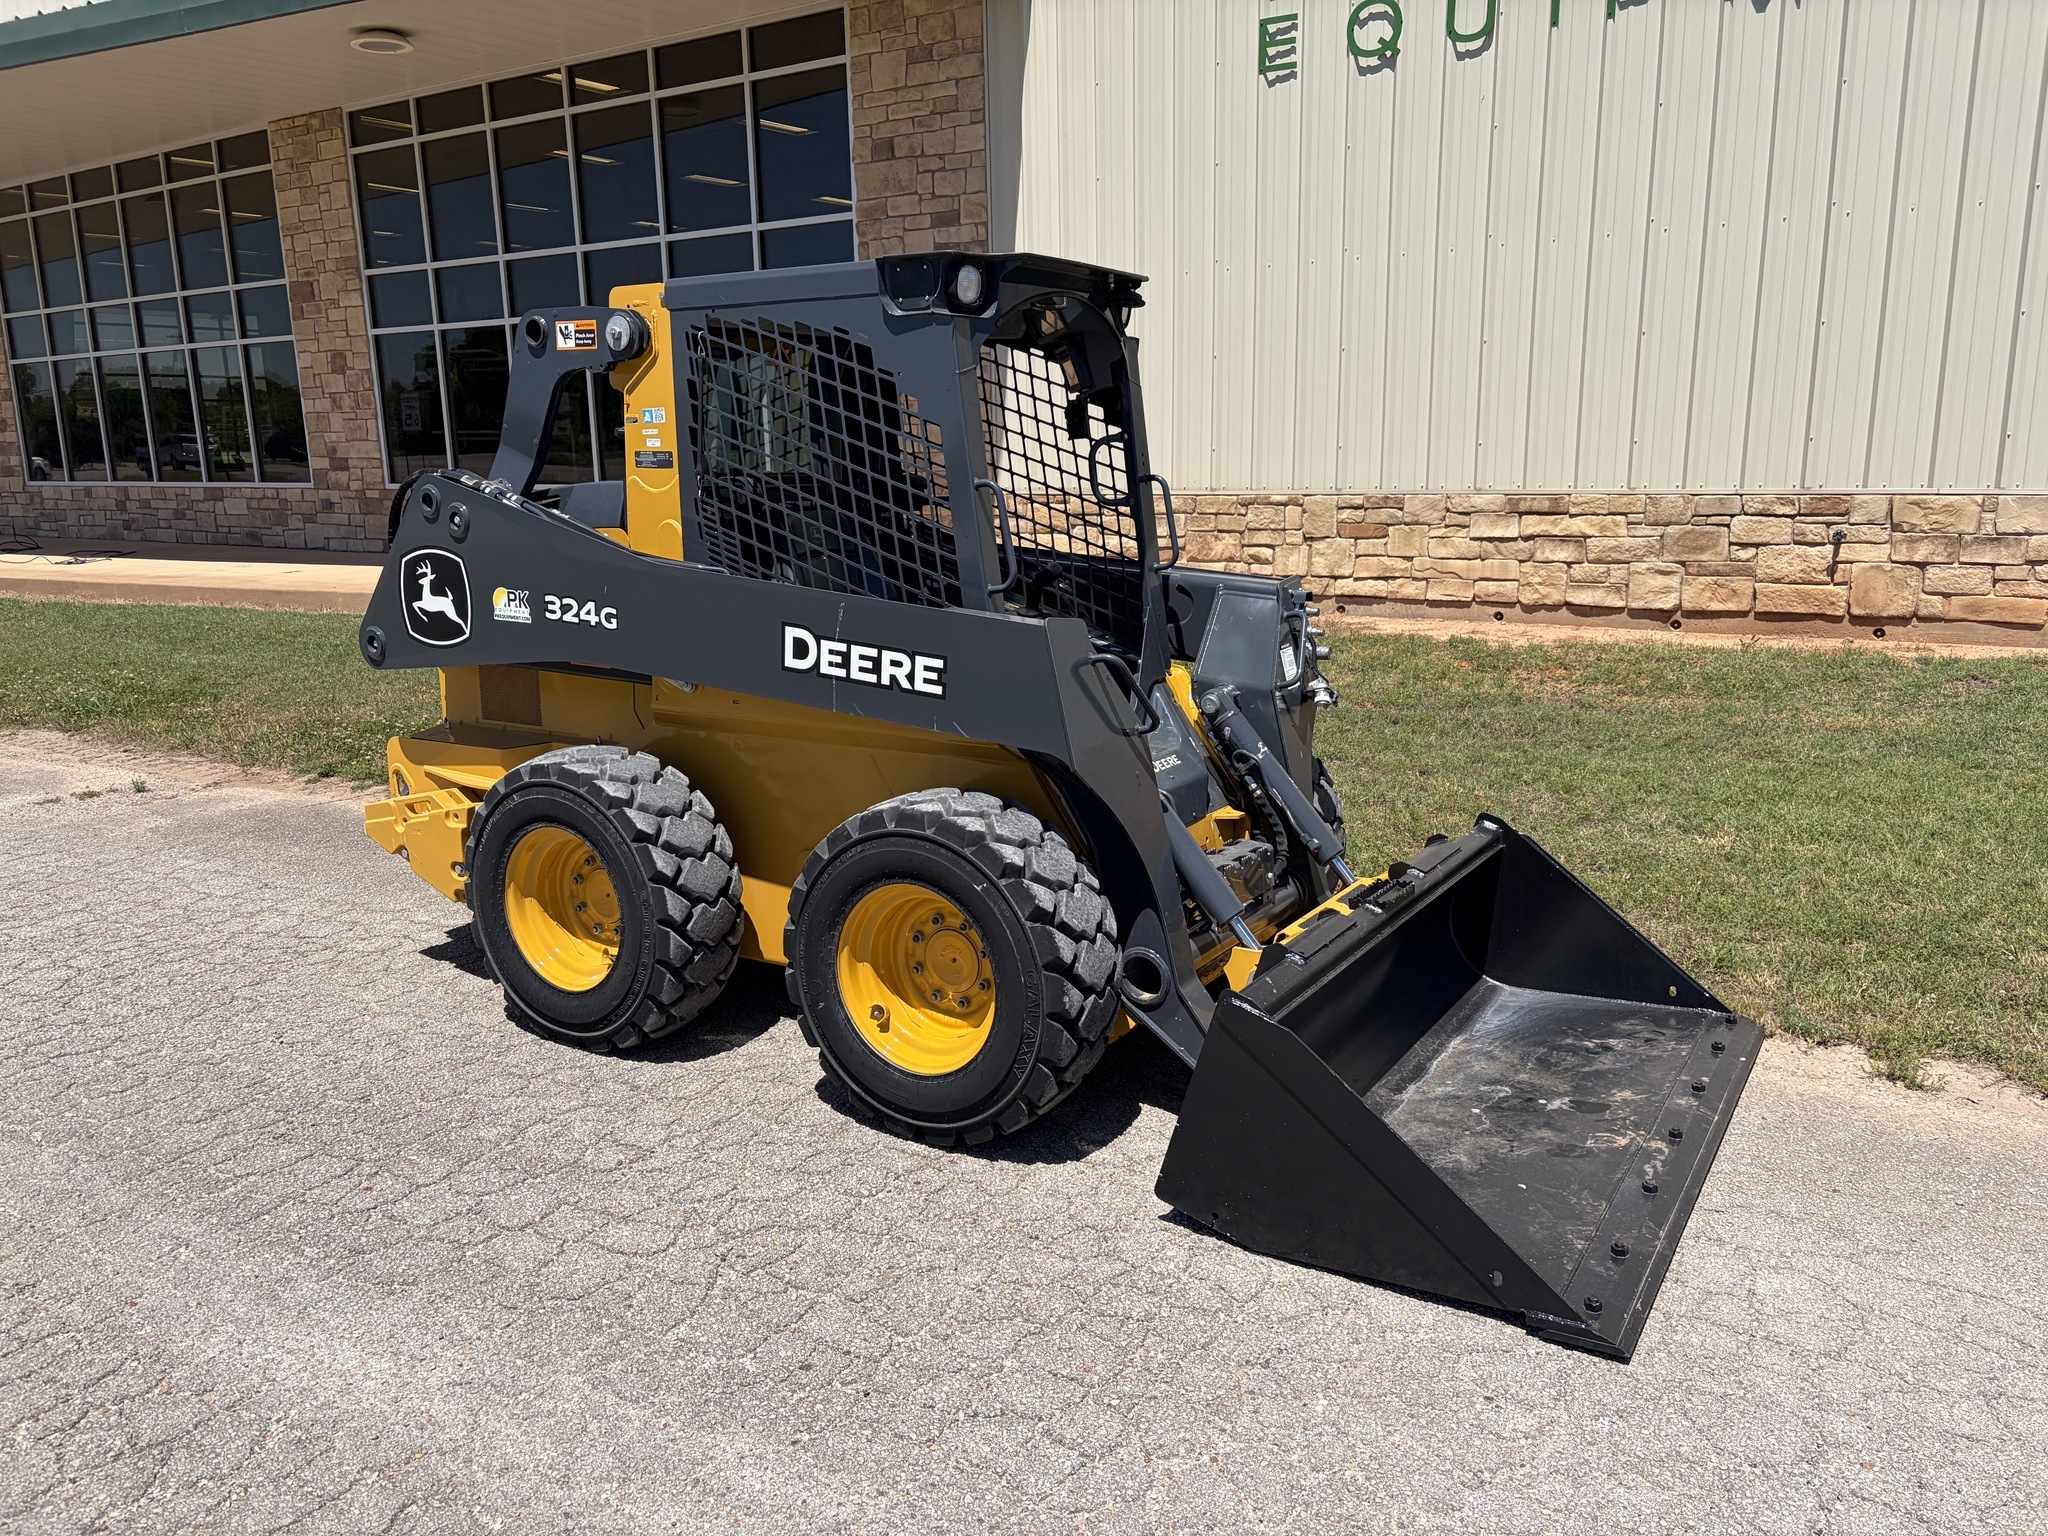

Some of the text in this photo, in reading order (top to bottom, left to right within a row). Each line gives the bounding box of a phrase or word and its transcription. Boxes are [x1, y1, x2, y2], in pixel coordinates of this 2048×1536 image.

[544, 595, 618, 630] 324G
[784, 625, 944, 695] DEERE
[1012, 968, 1041, 1079] GALAXY
